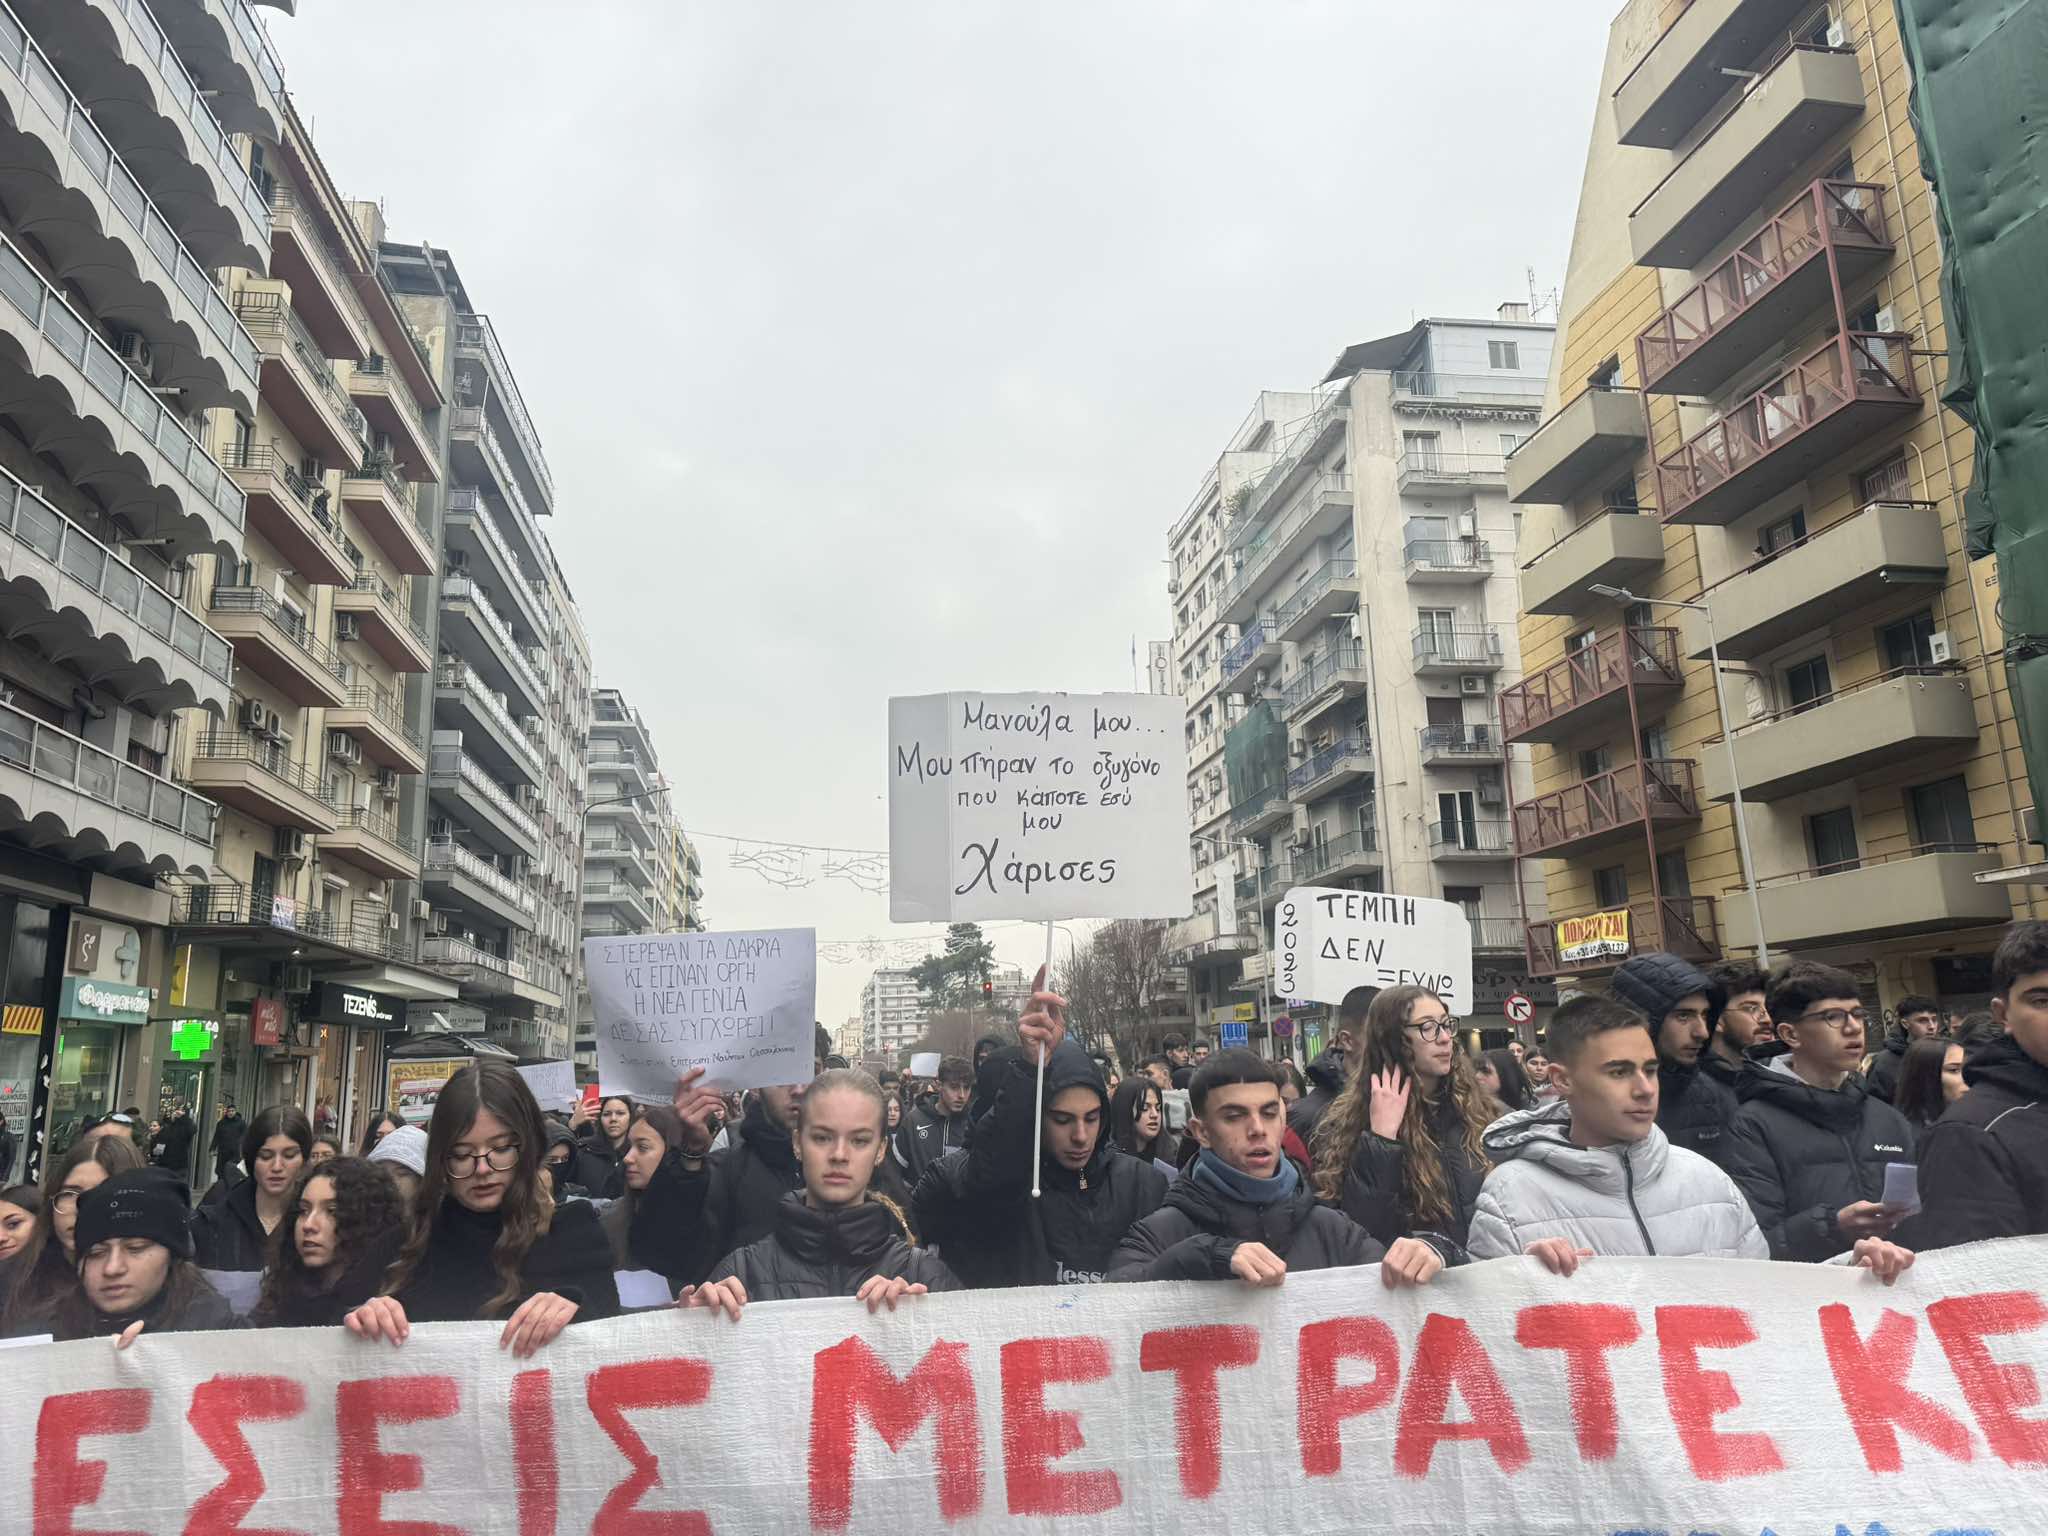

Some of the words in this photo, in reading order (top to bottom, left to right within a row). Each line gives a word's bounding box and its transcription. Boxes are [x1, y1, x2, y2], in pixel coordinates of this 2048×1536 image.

[963, 701, 1073, 741] Μανούλα
[897, 742, 951, 784] Μου
[1093, 751, 1160, 790] οξυγόνο
[1017, 785, 1088, 807] κάποτε
[1100, 787, 1132, 807] εσύ
[1022, 811, 1062, 836] μου
[955, 837, 1116, 895] Χάρισες
[1317, 893, 1415, 926] ΤΕΜΠΗ
[603, 941, 690, 964] ΣΤΕΡΕΨΑΝ
[697, 939, 717, 960] ΤΑ
[725, 936, 782, 960] ΔΑΚΡΥΑ
[1280, 903, 1298, 993] 2023
[1320, 936, 1385, 966] ΔΕΝ
[625, 967, 643, 989] ΚΙ
[716, 962, 756, 984] ΟΡΓΗ
[343, 994, 377, 1018] TEZENIS
[634, 992, 646, 1016] Η
[652, 990, 686, 1015] ΝΕΑ
[691, 986, 748, 1013] ΓΕΝΙΑ
[634, 1021, 674, 1043] ΣΑΣ
[1879, 1144, 1904, 1153] Columbia
[1055, 1261, 1108, 1285] less
[32, 1356, 713, 1536] ΕΣΕΙΣ
[807, 1301, 1788, 1534] ΜΕΤΡΑΤΕ
